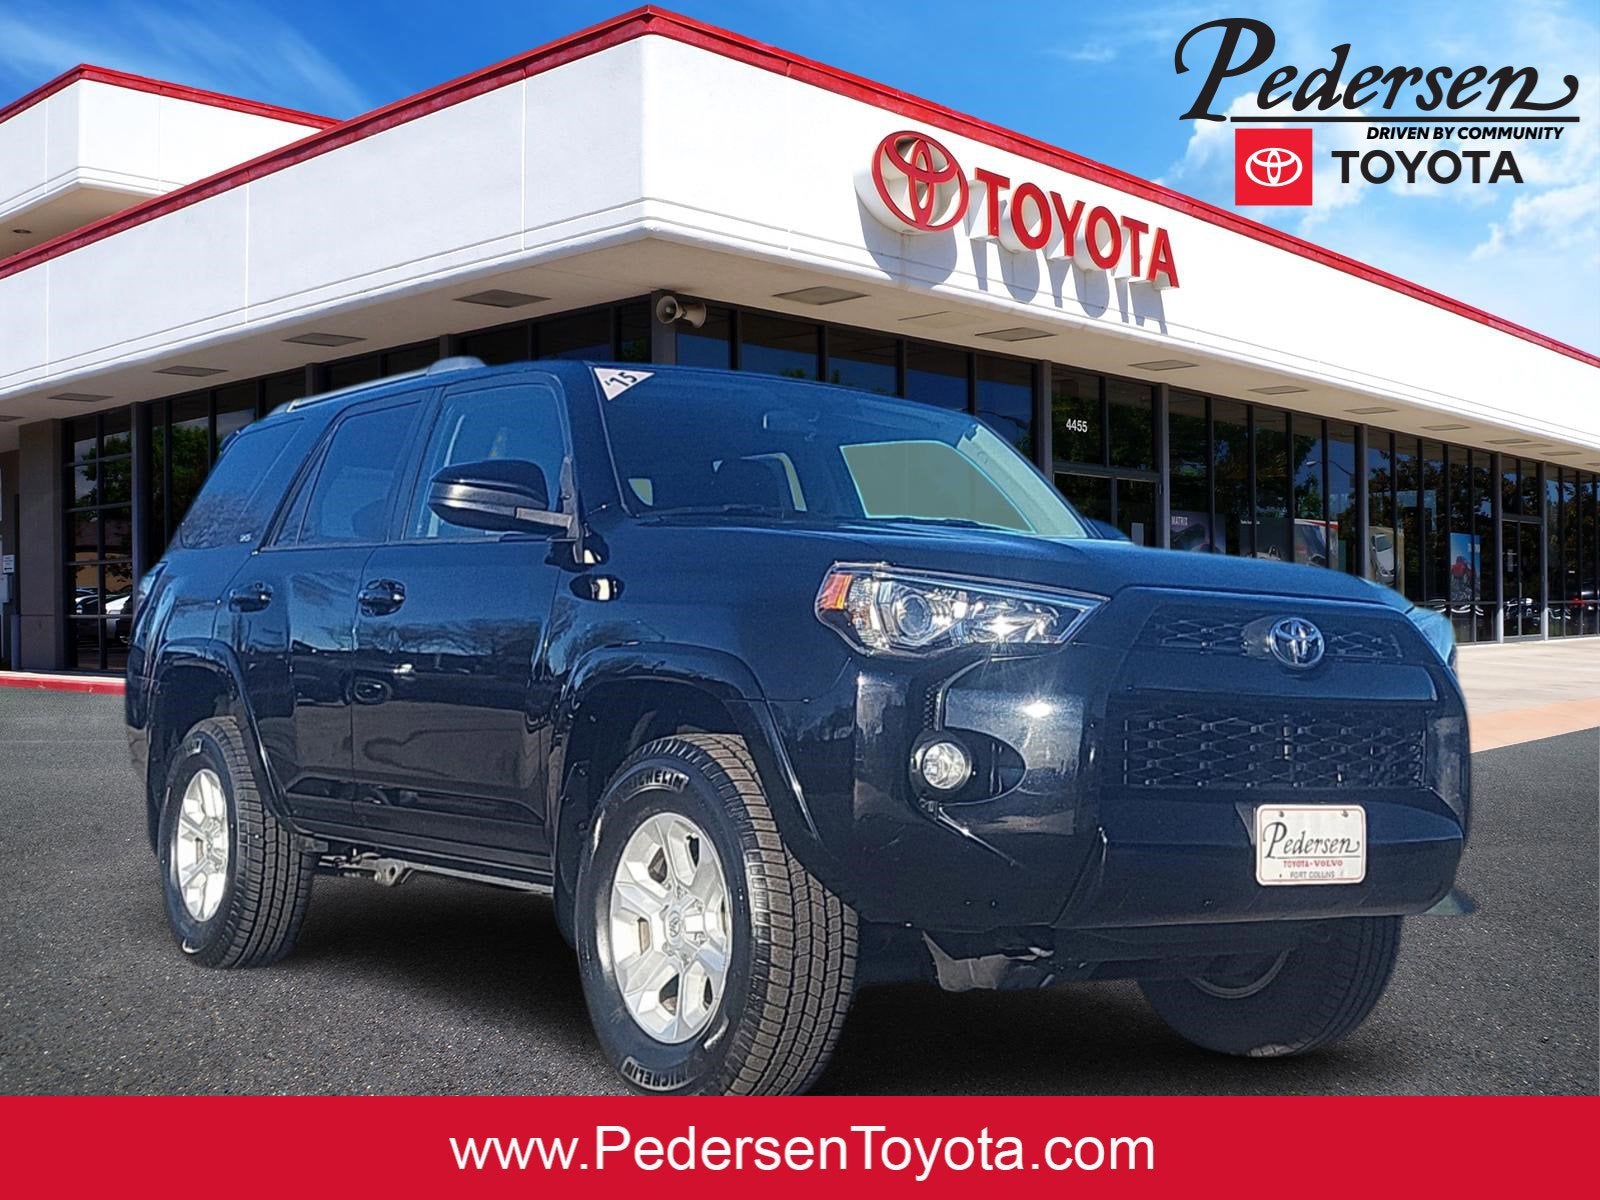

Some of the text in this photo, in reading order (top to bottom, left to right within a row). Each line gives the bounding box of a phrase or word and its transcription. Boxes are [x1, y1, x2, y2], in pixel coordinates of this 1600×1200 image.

[974, 167, 1179, 288] TOYOTA
[1065, 418, 1088, 433] 4455
[1171, 516, 1188, 526] MATRIX
[1263, 821, 1360, 859] Pedersen
